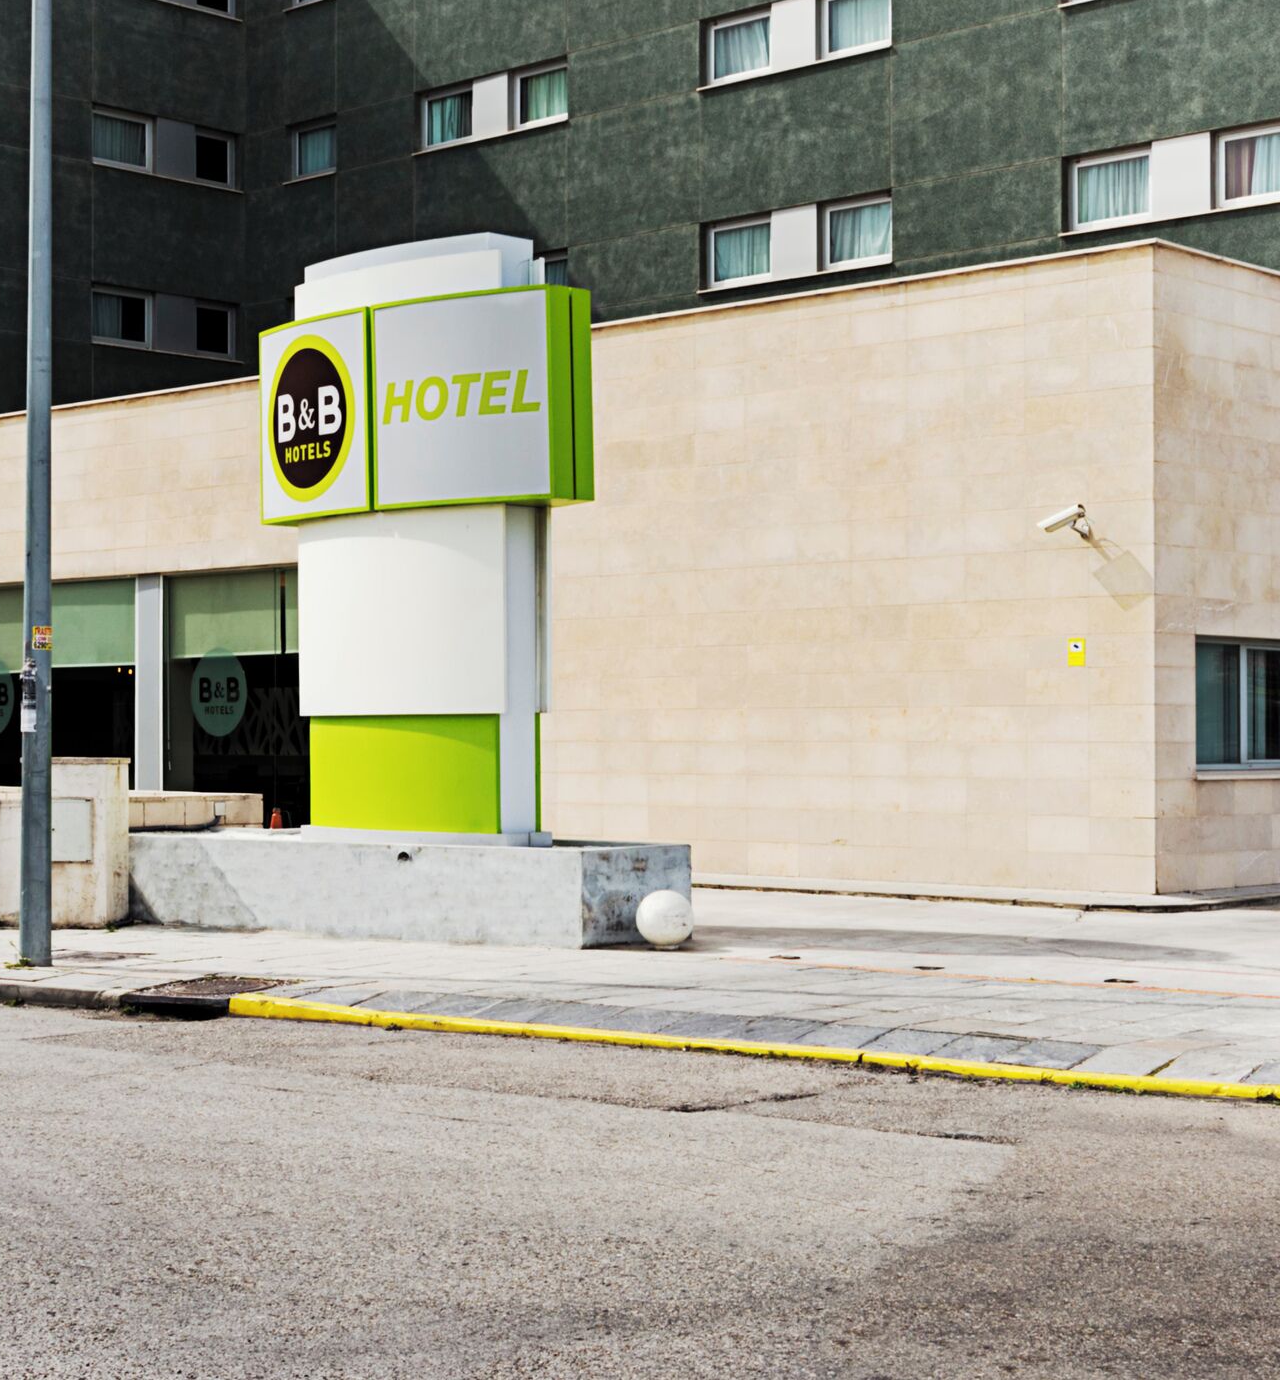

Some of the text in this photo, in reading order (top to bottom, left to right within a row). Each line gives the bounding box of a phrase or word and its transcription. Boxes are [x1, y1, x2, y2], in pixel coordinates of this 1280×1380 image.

[382, 369, 541, 426] HOTEL
[277, 384, 343, 444] B&B
[285, 440, 331, 464] HOTELS
[199, 676, 240, 703] B&B
[204, 705, 234, 715] HOTELS
